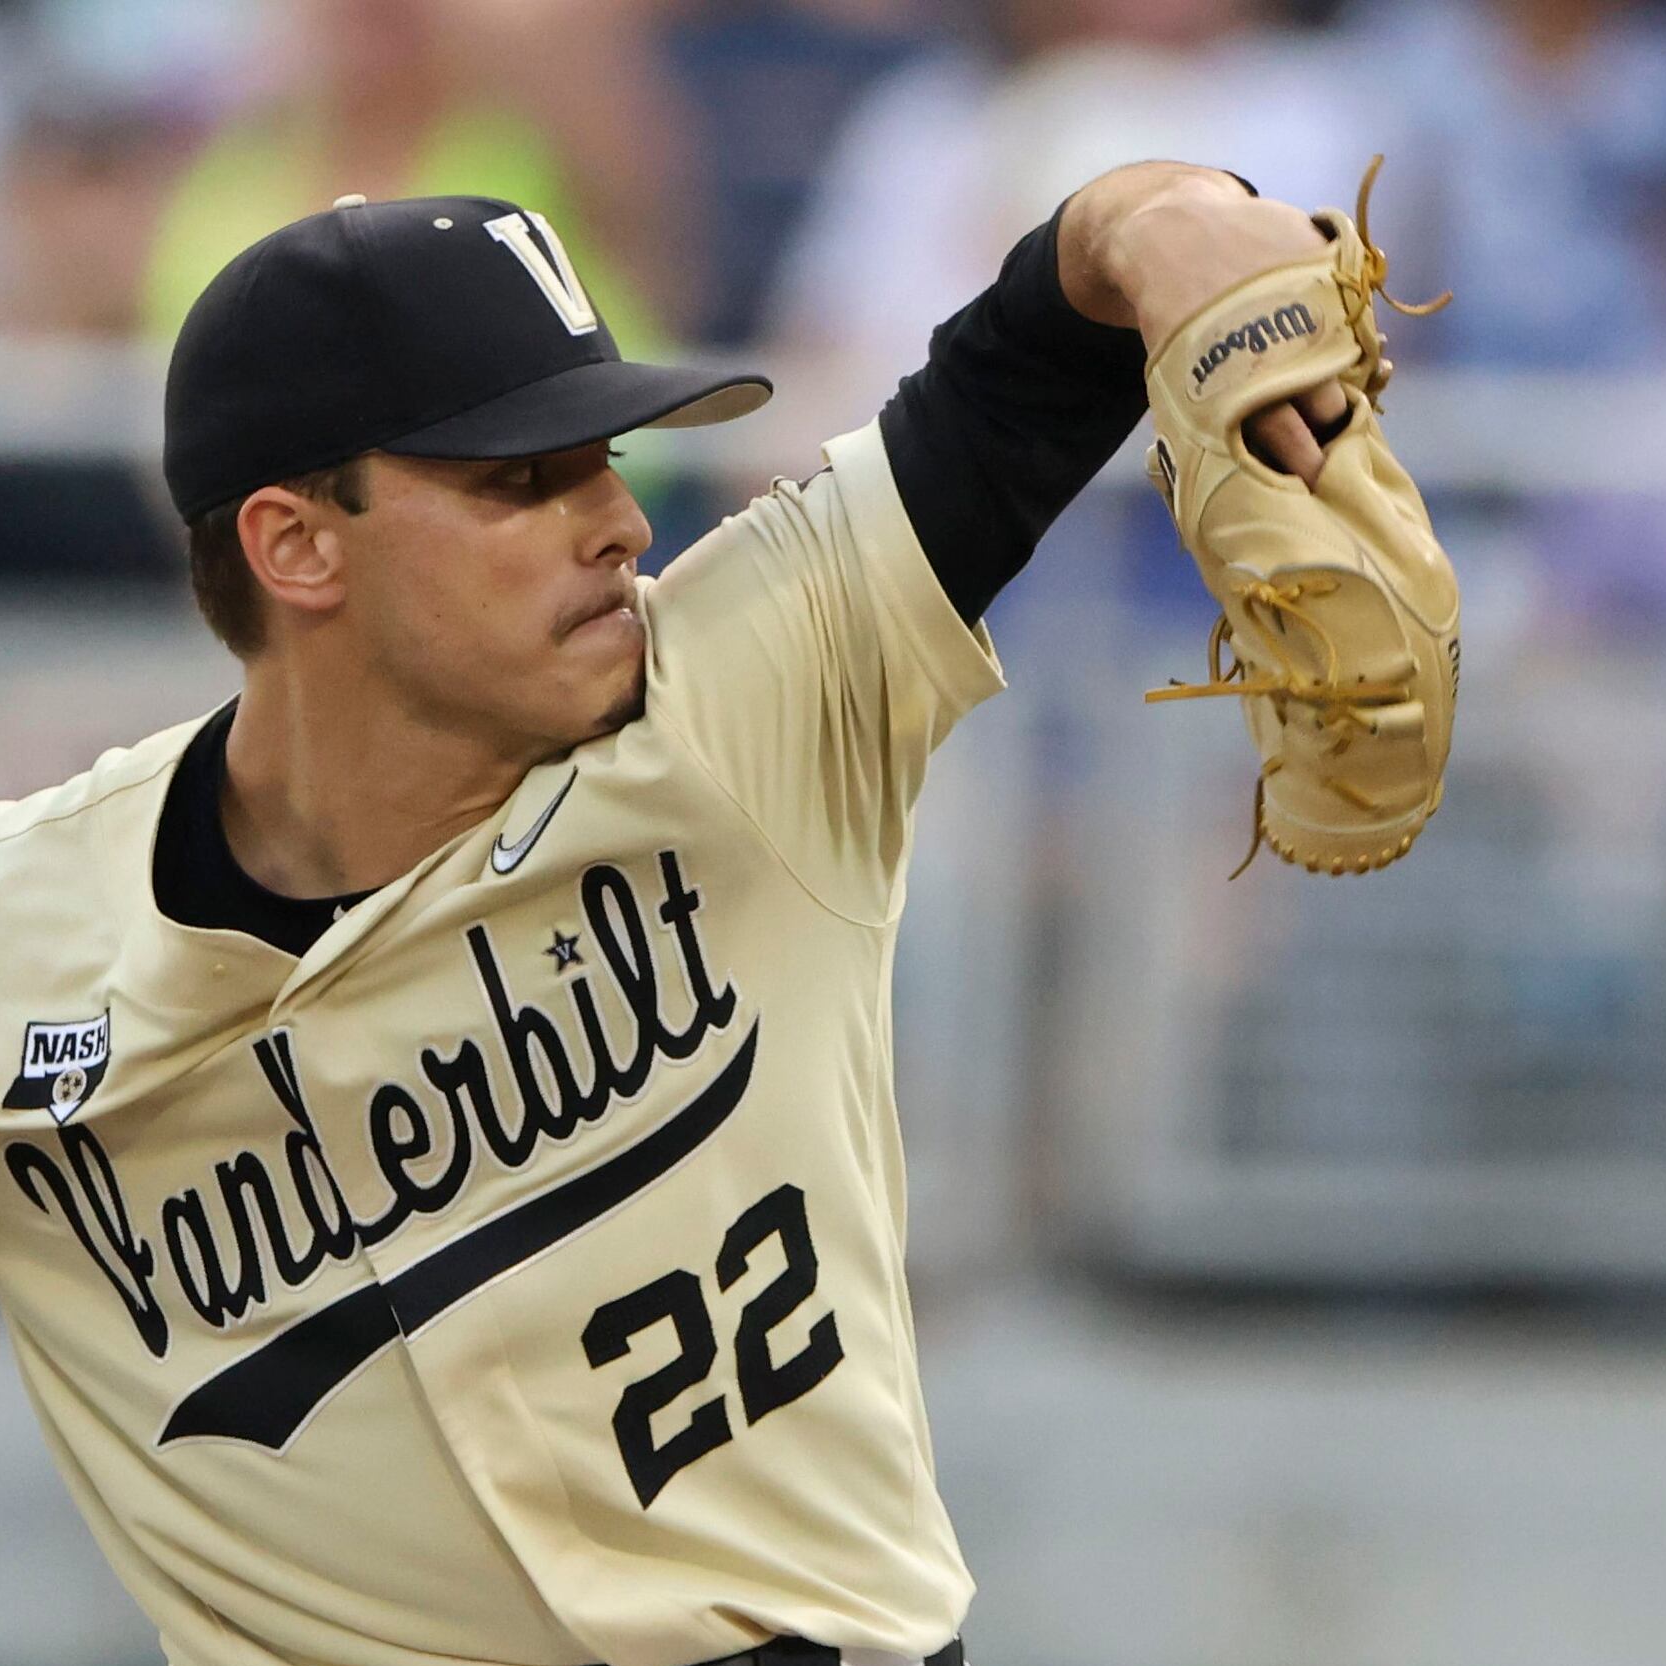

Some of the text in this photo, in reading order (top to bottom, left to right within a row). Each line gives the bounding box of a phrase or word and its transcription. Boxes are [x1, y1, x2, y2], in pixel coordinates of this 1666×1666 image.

[483, 210, 597, 336] V
[1191, 302, 1317, 385] Wilson
[2, 849, 738, 1360] Vanderbilt
[30, 1021, 107, 1065] NASH
[582, 1183, 843, 1511] 22
